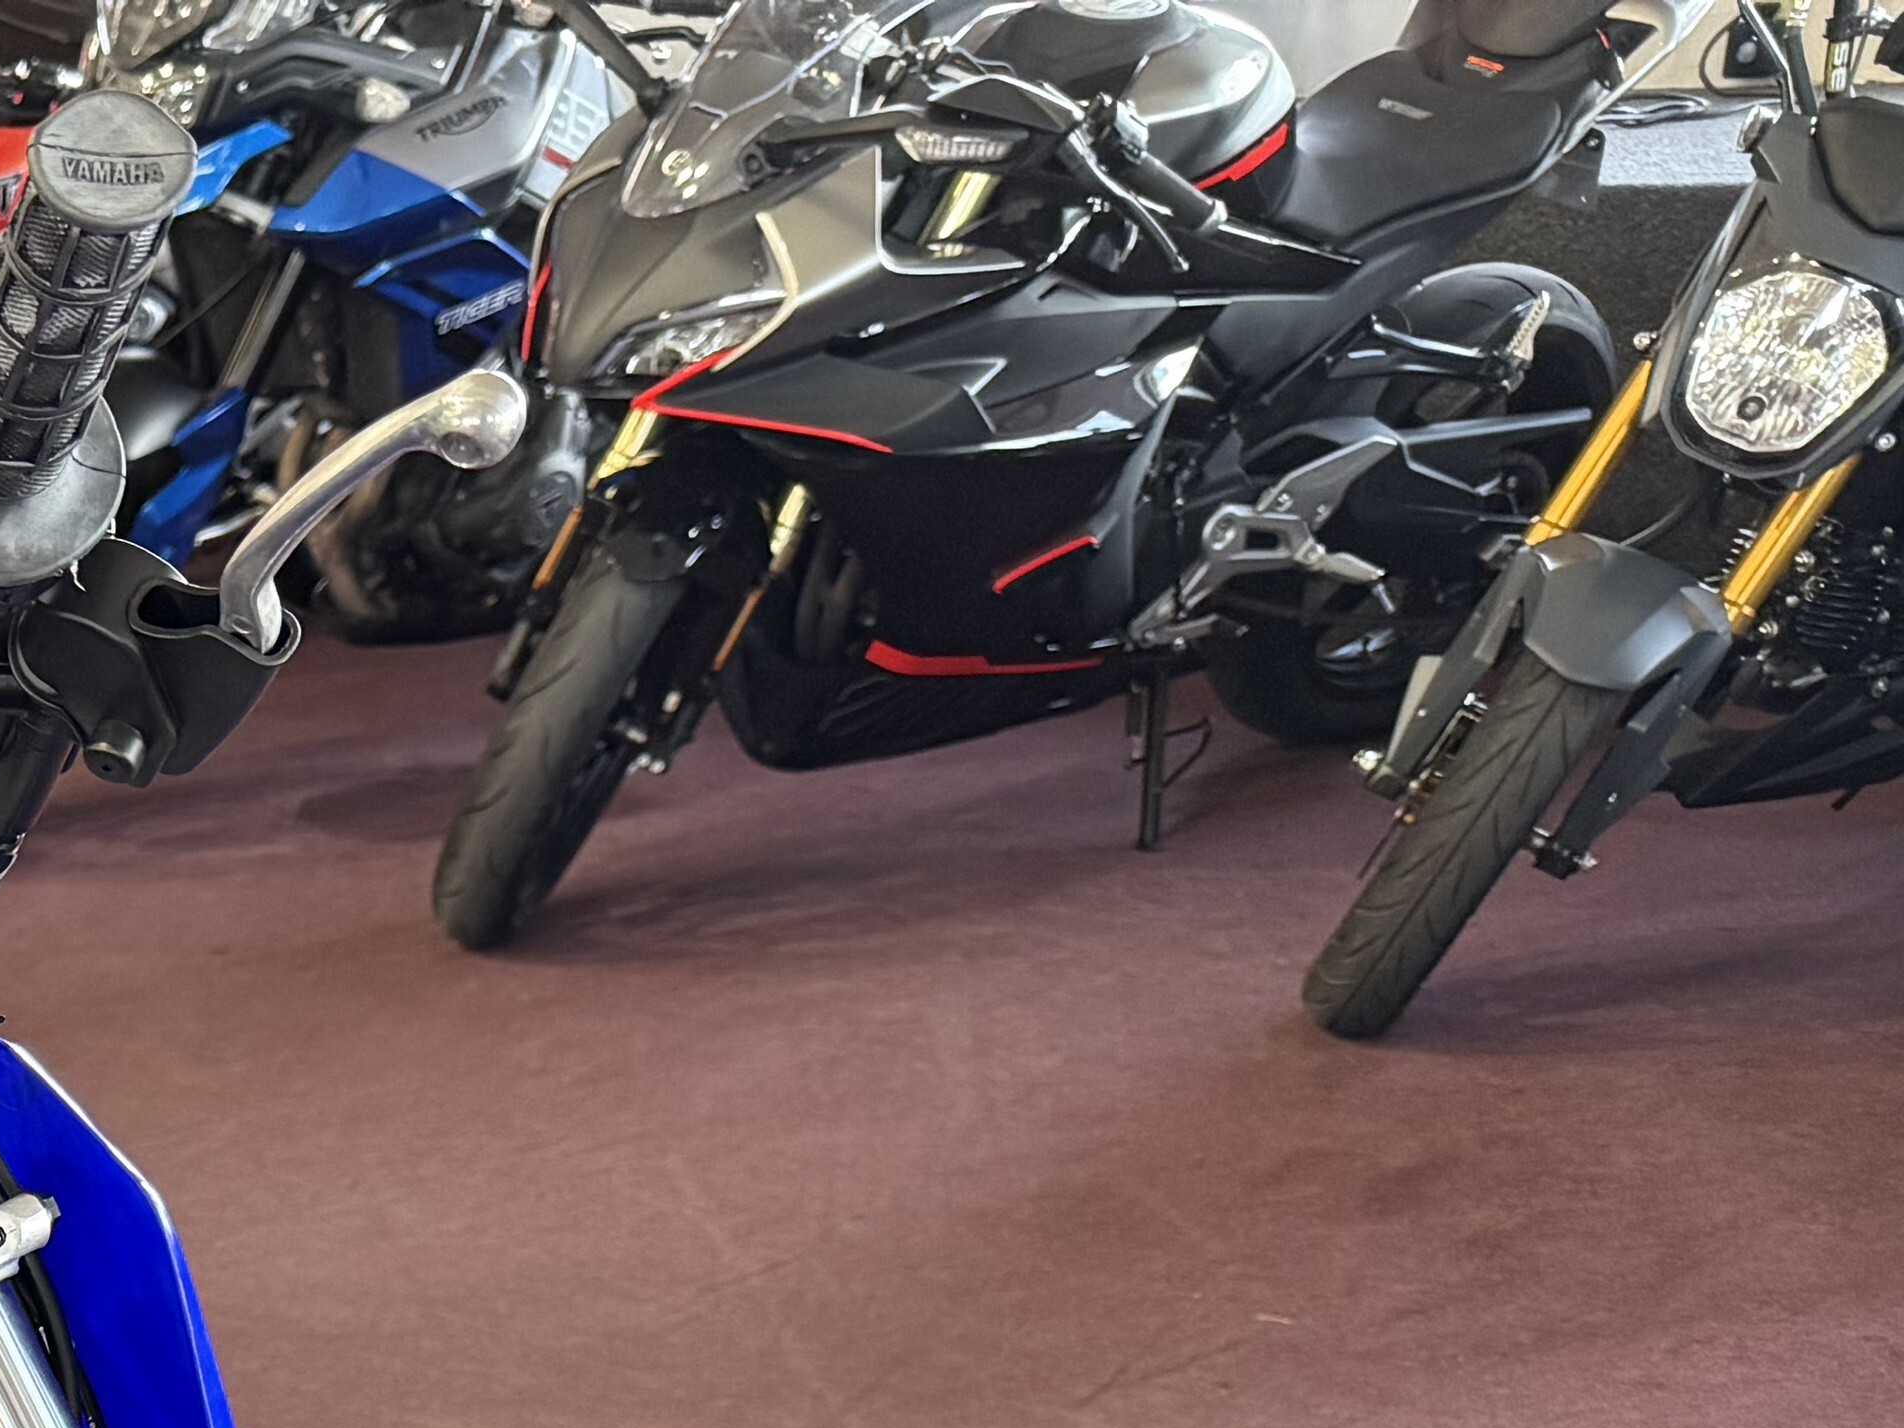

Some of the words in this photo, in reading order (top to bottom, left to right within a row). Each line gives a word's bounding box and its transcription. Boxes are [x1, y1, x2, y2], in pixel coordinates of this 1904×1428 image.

[416, 96, 508, 142] TRIUMPH
[62, 157, 165, 186] YAMAHA
[434, 280, 526, 335] TIGER
